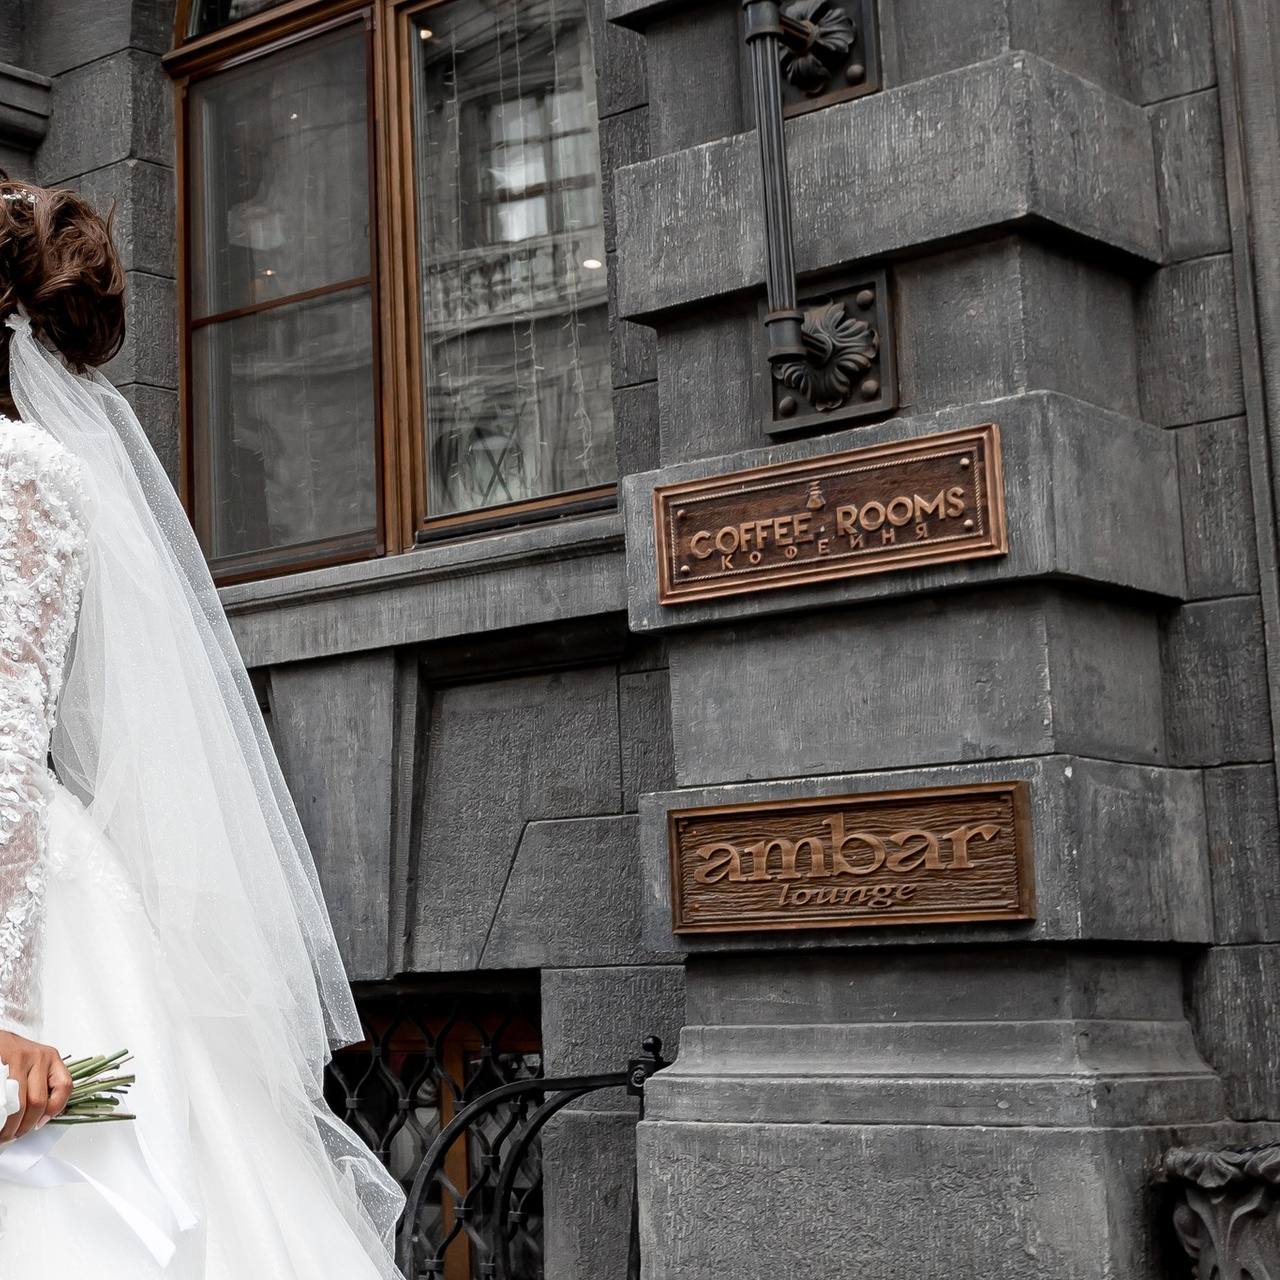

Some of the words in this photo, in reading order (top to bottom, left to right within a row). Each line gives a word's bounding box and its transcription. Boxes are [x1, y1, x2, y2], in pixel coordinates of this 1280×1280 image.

[690, 512, 815, 559] COFFEE
[836, 486, 965, 537] ROOMS
[721, 523, 929, 570] КОФЕЙНЯ
[693, 812, 1002, 884] ambar
[778, 883, 918, 909] lounge
